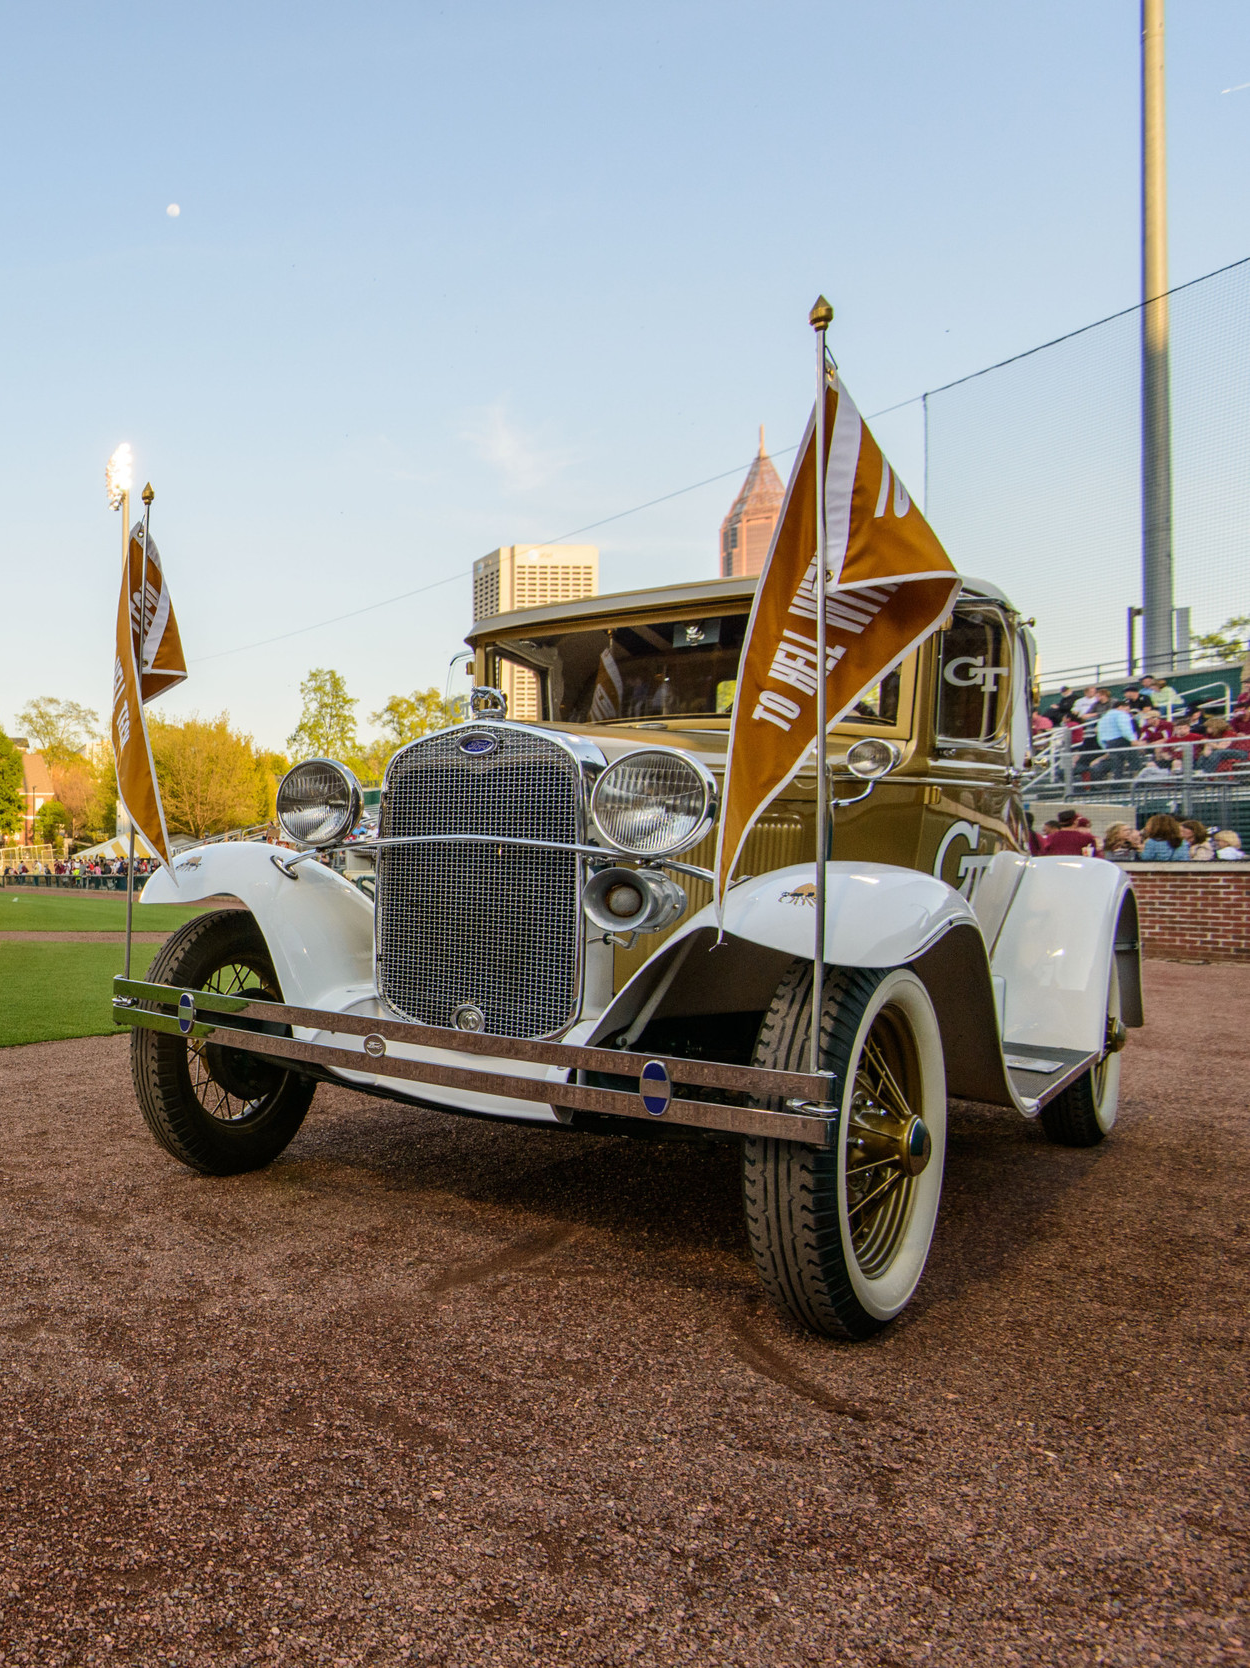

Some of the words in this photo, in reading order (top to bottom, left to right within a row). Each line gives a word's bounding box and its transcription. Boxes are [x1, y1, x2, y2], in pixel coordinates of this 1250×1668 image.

[768, 628, 847, 697] HELL
[944, 655, 1009, 692] GT
[752, 690, 801, 732] TO
